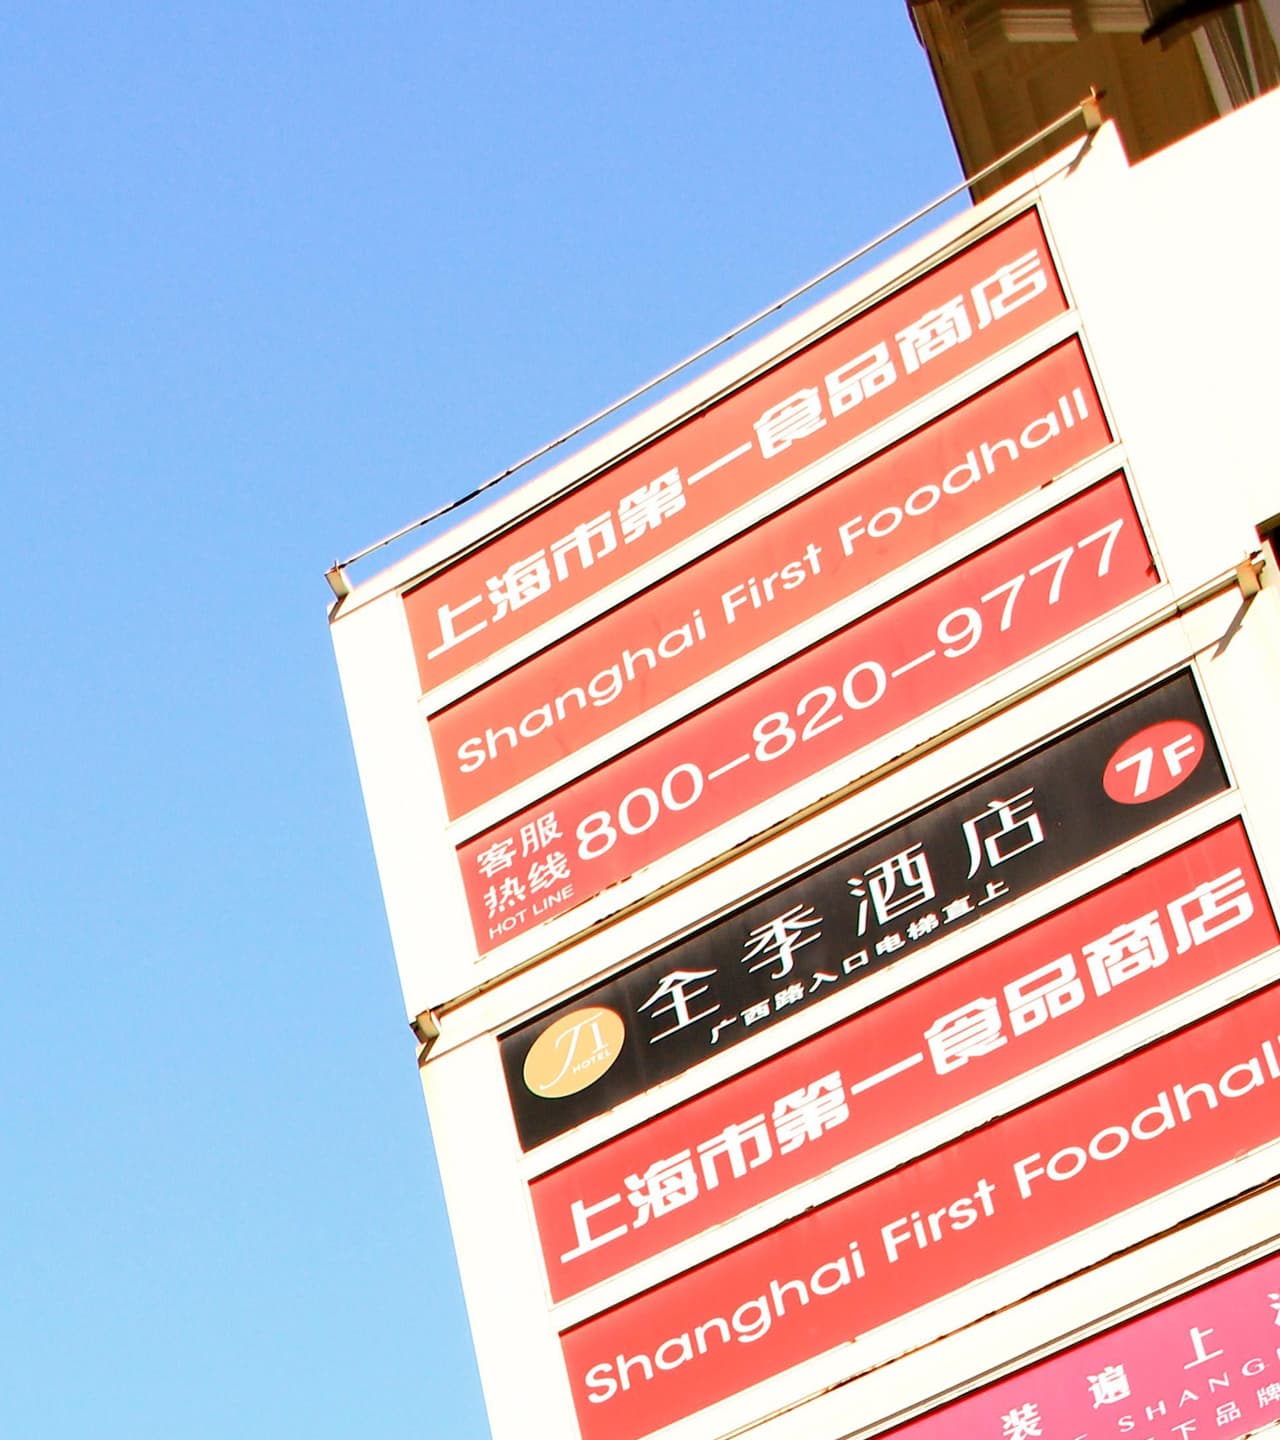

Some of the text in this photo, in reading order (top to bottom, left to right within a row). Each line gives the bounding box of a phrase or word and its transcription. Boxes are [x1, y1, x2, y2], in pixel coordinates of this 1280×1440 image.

[426, 247, 1048, 660] 上海市第一食品商店
[457, 387, 1090, 773] Shanghai First Foodhall
[1115, 734, 1196, 798] 7F
[476, 811, 566, 878] 客服
[484, 851, 572, 919] 热线
[488, 884, 575, 941] HOT LINE
[637, 786, 1045, 1045] 全季酒店
[560, 867, 1255, 1265] 上海市第一食品商店
[572, 1048, 612, 1075] HOTEL
[585, 1034, 1280, 1406] Shanghai First Foodhal
[1118, 1347, 1280, 1433] SHANG
